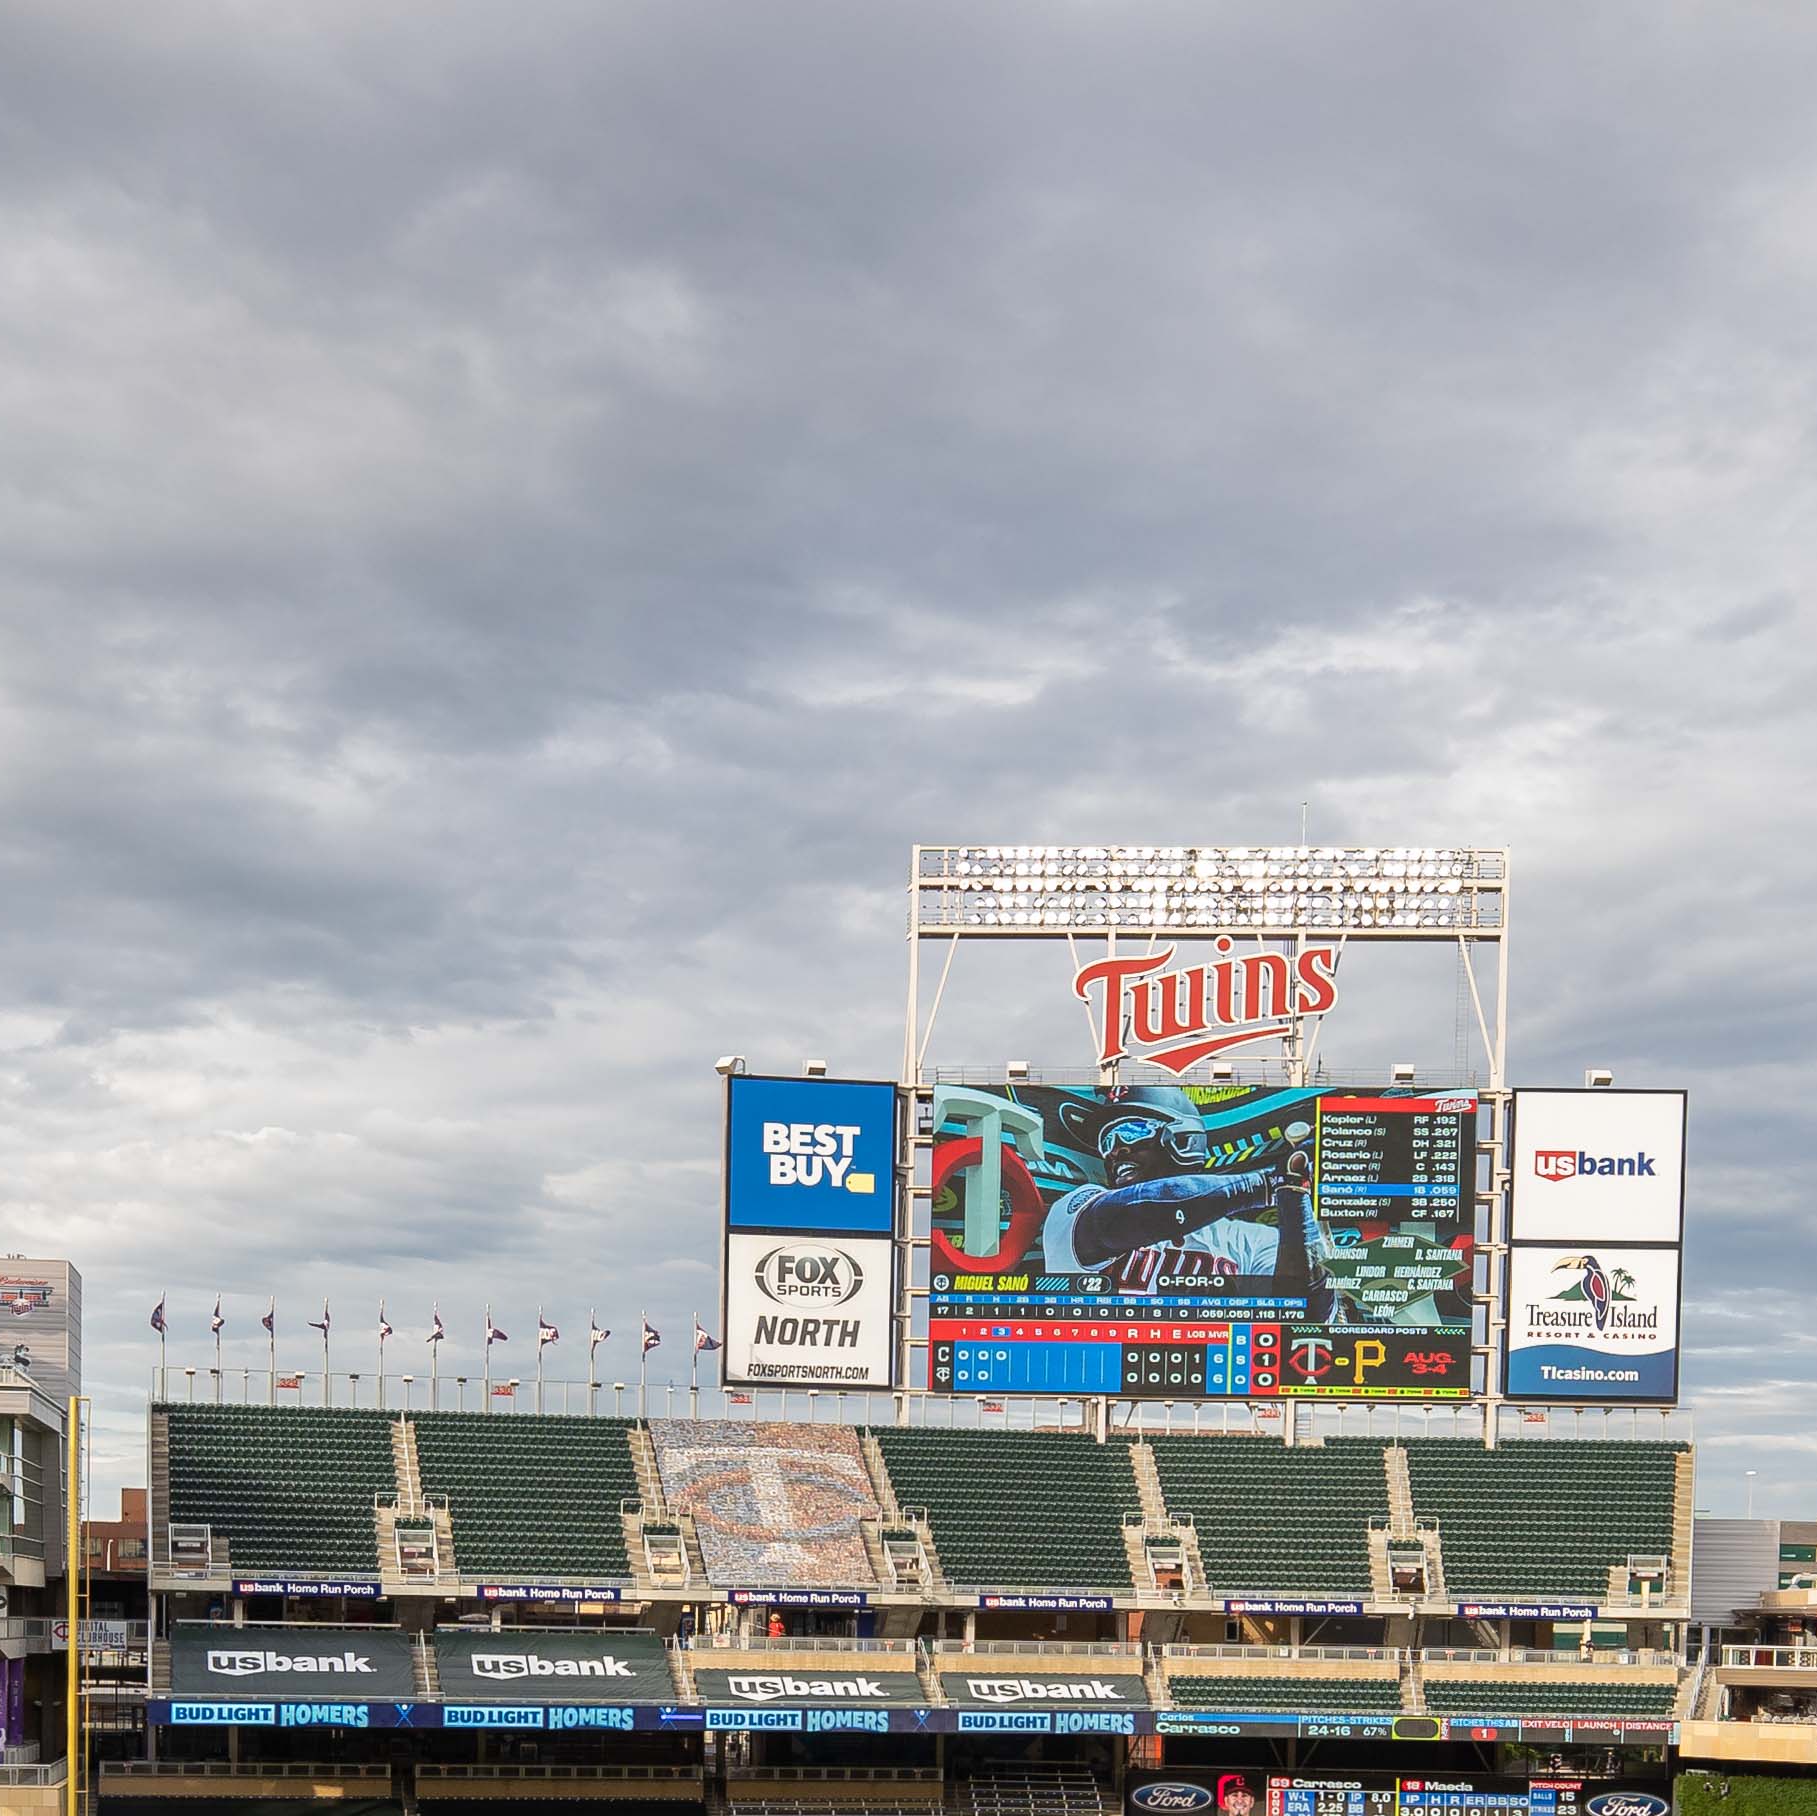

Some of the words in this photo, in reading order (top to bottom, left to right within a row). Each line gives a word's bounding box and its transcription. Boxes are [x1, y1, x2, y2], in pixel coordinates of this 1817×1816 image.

[1072, 934, 1338, 1078] Twins
[763, 1122, 860, 1157] BEST
[770, 1154, 852, 1187] BUY
[1383, 1237, 1413, 1248] ZIMMER
[778, 1255, 840, 1285] FOX
[953, 1276, 993, 1290] MIGUEL
[998, 1274, 1028, 1290] SANÓ
[777, 1285, 841, 1297] SPORTS
[1362, 1290, 1408, 1302] CARRASCO
[1526, 1304, 1592, 1328] Treasure
[1610, 1305, 1657, 1328] Island
[754, 1315, 860, 1348] NORTH
[1329, 1327, 1394, 1335] SCOREBOARD
[1395, 1327, 1427, 1335] POSTS
[1604, 1332, 1657, 1340] CASINO
[1403, 1353, 1456, 1364] AUG.
[747, 1363, 869, 1380] FOXSPORTSNORTH.COM
[287, 1584, 318, 1593] Home
[320, 1584, 341, 1594] Run
[343, 1585, 374, 1594] Porch
[175, 1707, 214, 1721] BUD
[217, 1707, 271, 1721] LIGHT
[281, 1705, 369, 1727] HOMERS
[1156, 1723, 1241, 1734] Carrasco
[1578, 1721, 1616, 1729] LAUNCH
[1626, 1722, 1672, 1730] DISTANCE
[1425, 1782, 1473, 1791] Maeda
[1147, 1788, 1195, 1807] Ford
[1601, 1797, 1652, 1816] Ford
